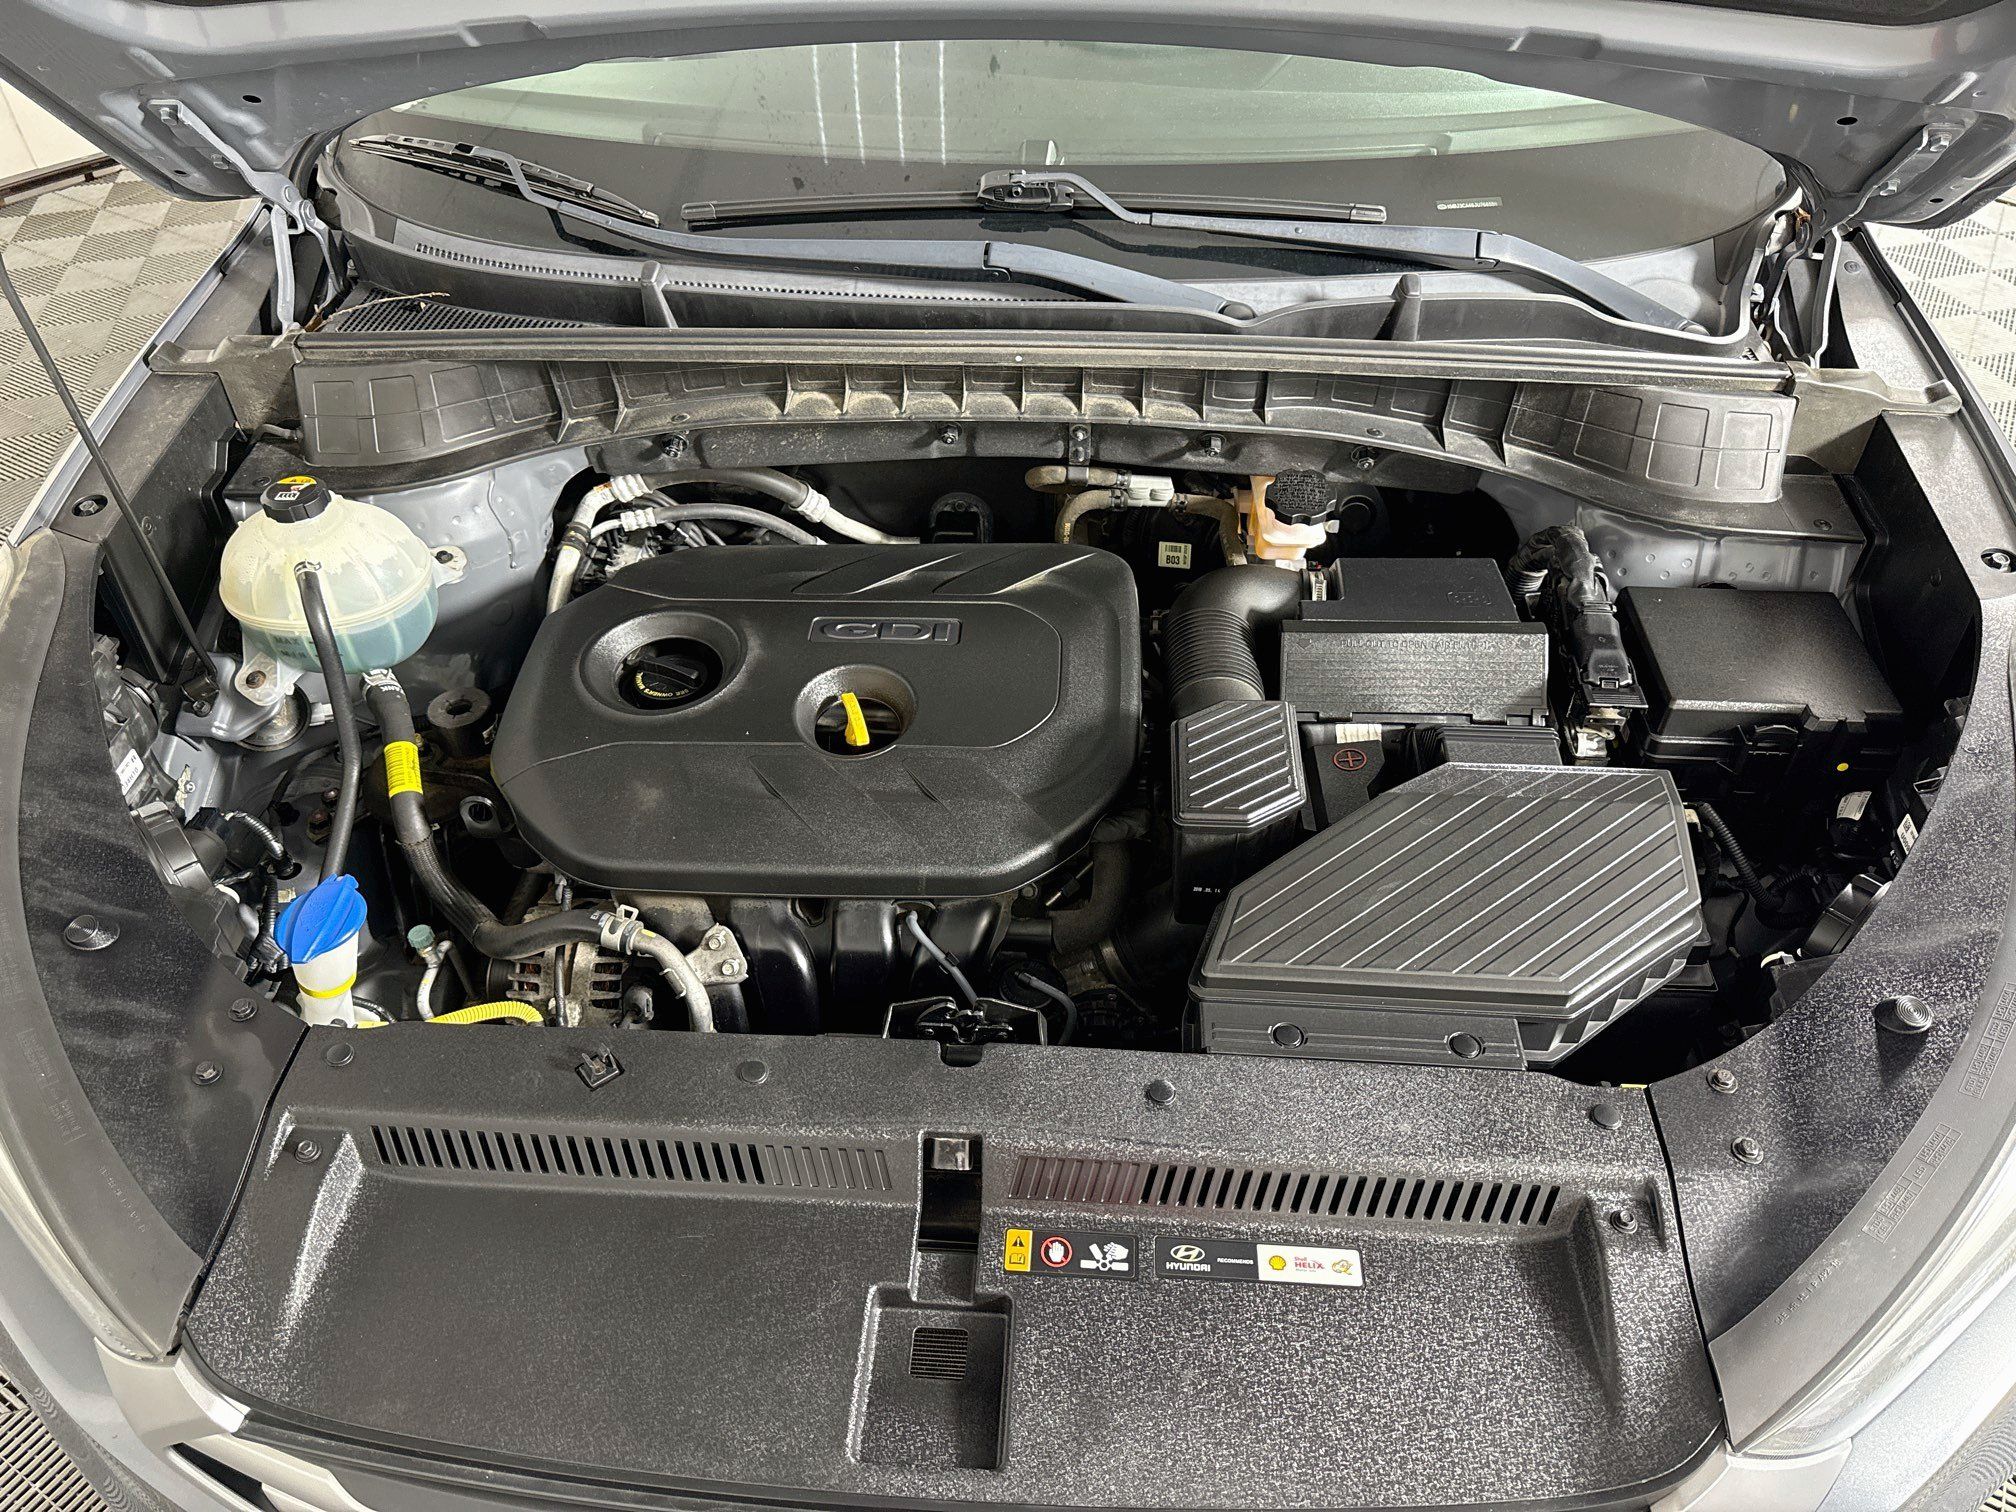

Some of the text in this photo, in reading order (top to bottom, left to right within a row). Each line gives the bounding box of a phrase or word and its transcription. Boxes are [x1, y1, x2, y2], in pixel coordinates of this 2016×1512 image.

[821, 621, 951, 642] GDI
[643, 687, 674, 698] OWNER'S
[1165, 1261, 1211, 1272] HYUNDAI
[1216, 1257, 1254, 1265] RECOMMENDS
[1294, 1261, 1325, 1269] HELIX
